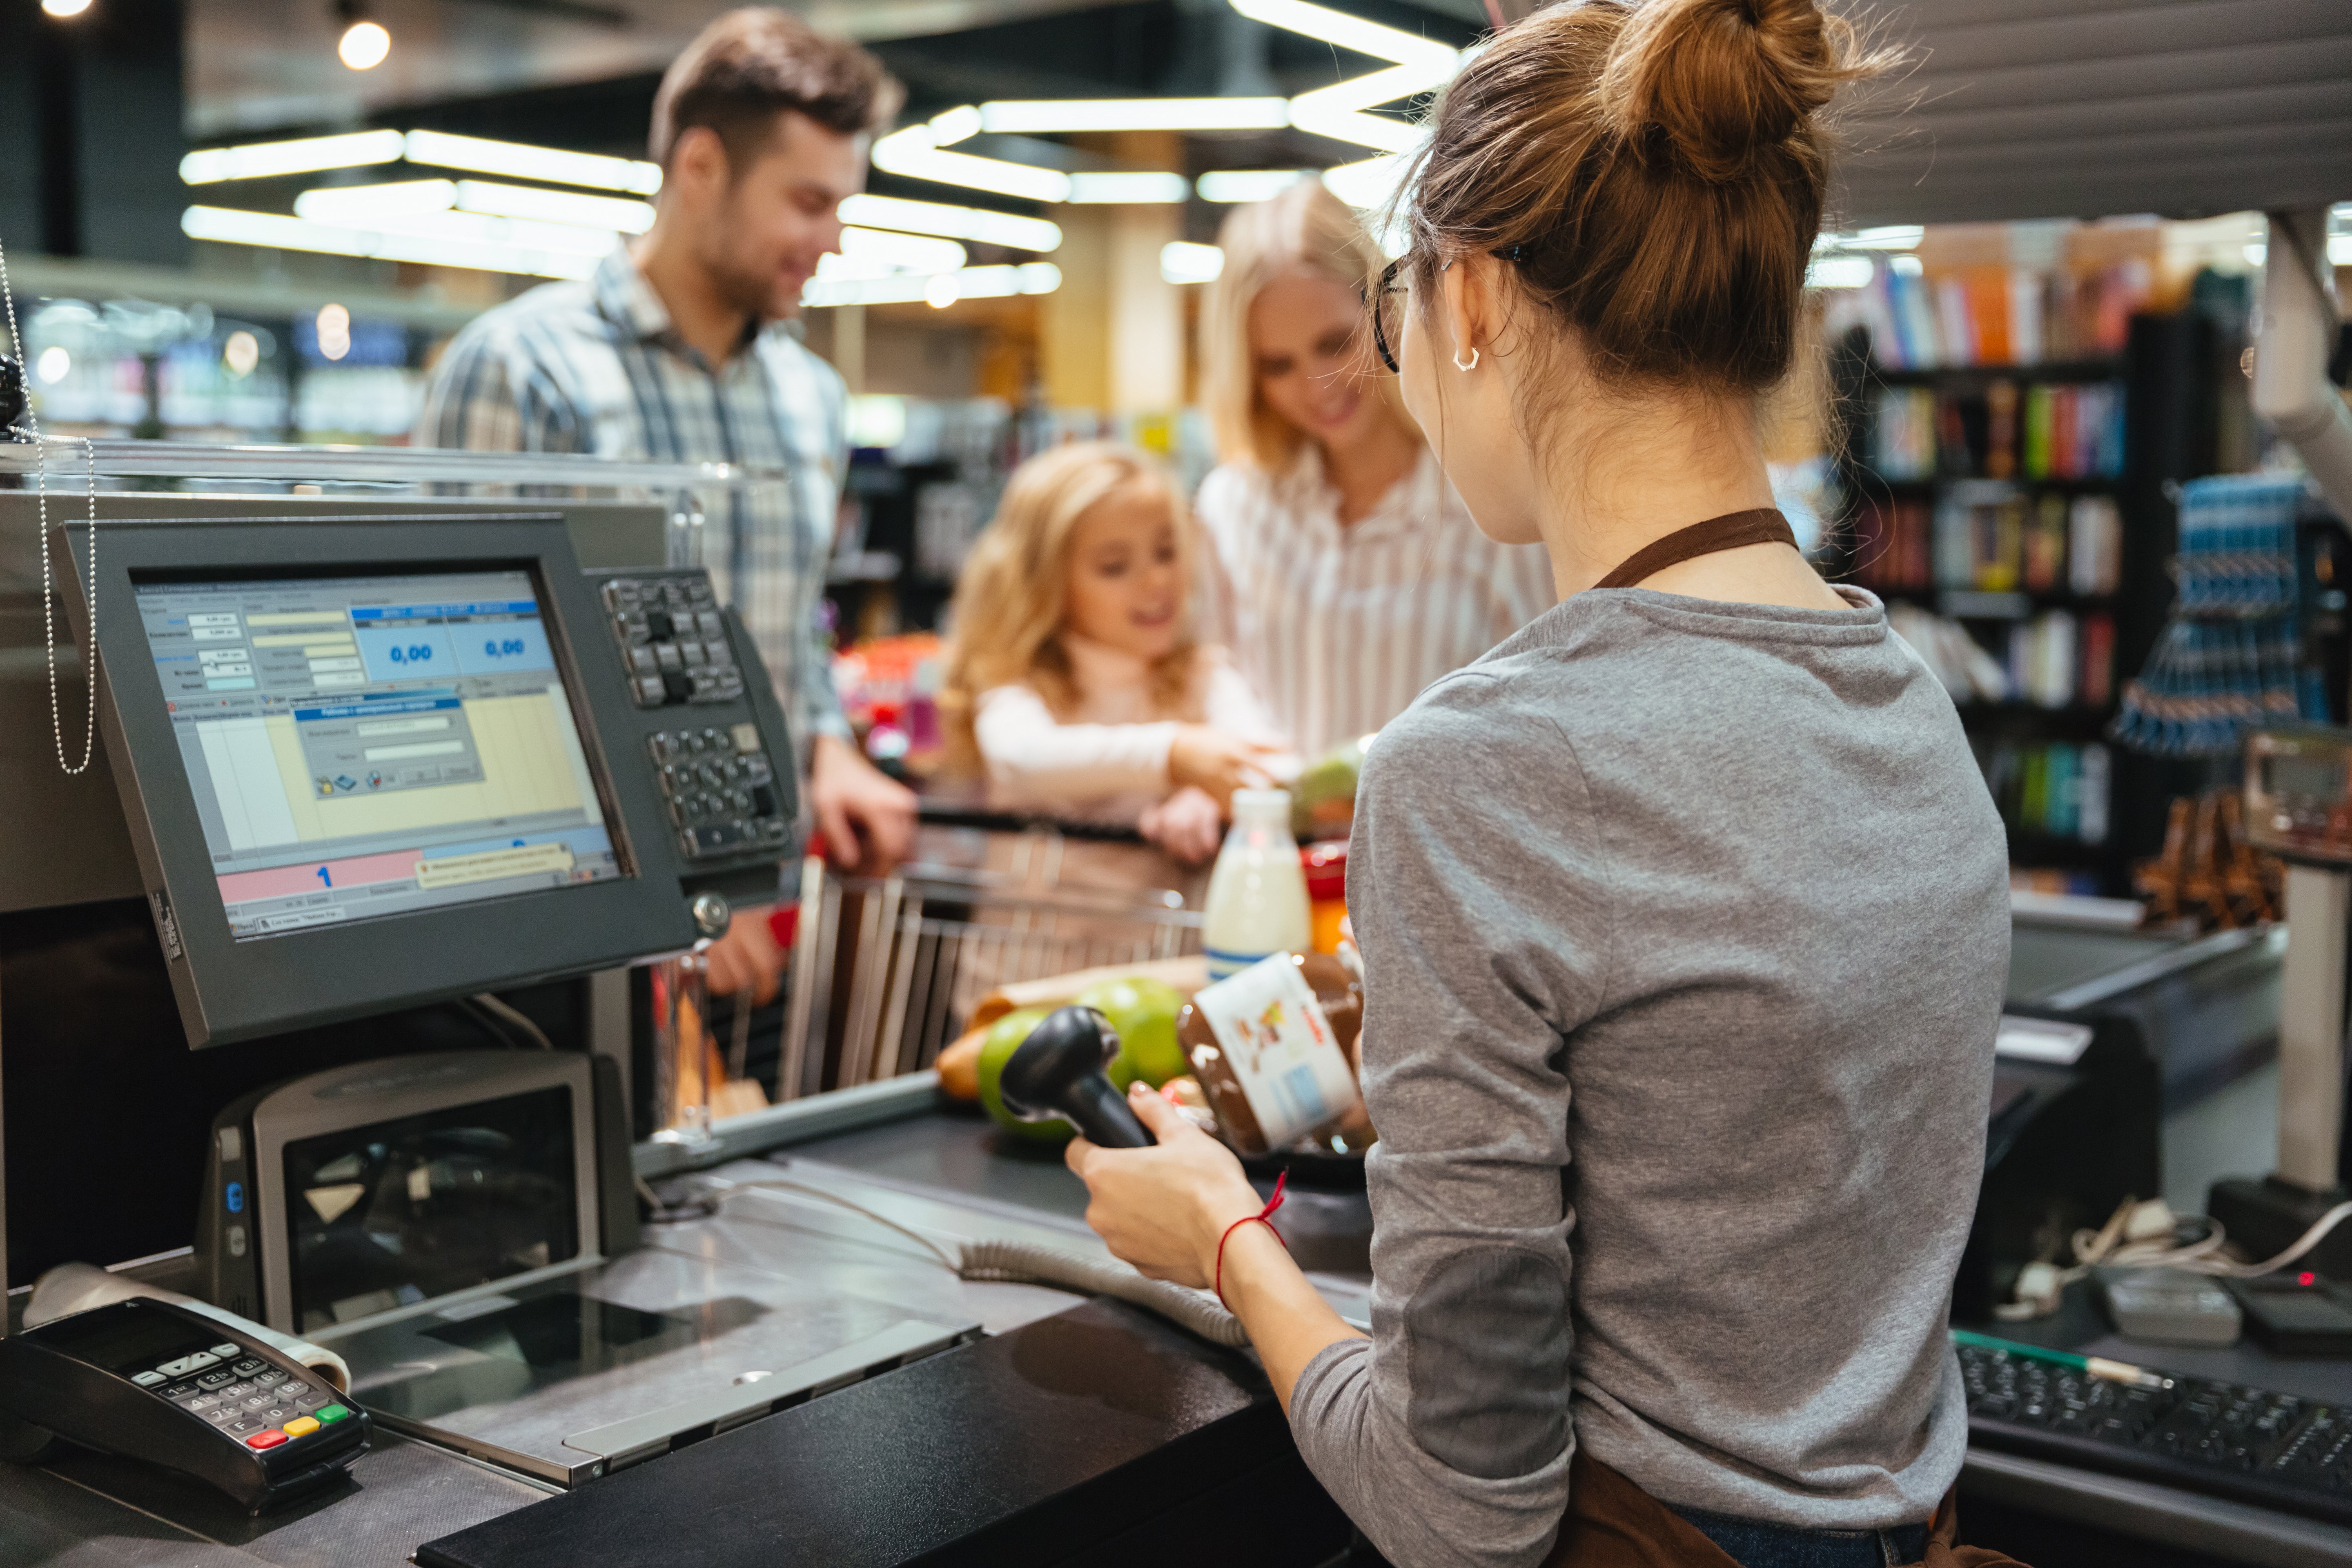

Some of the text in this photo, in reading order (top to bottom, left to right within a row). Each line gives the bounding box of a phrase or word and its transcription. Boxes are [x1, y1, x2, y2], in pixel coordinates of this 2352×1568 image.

[485, 639, 525, 659] 0,00
[390, 644, 432, 665] 0,00
[317, 866, 332, 888] 1
[206, 1374, 220, 1383] 2
[227, 1386, 241, 1394] 5
[192, 1399, 203, 1409] 4
[211, 1410, 223, 1418] 7
[234, 1422, 245, 1430] F
